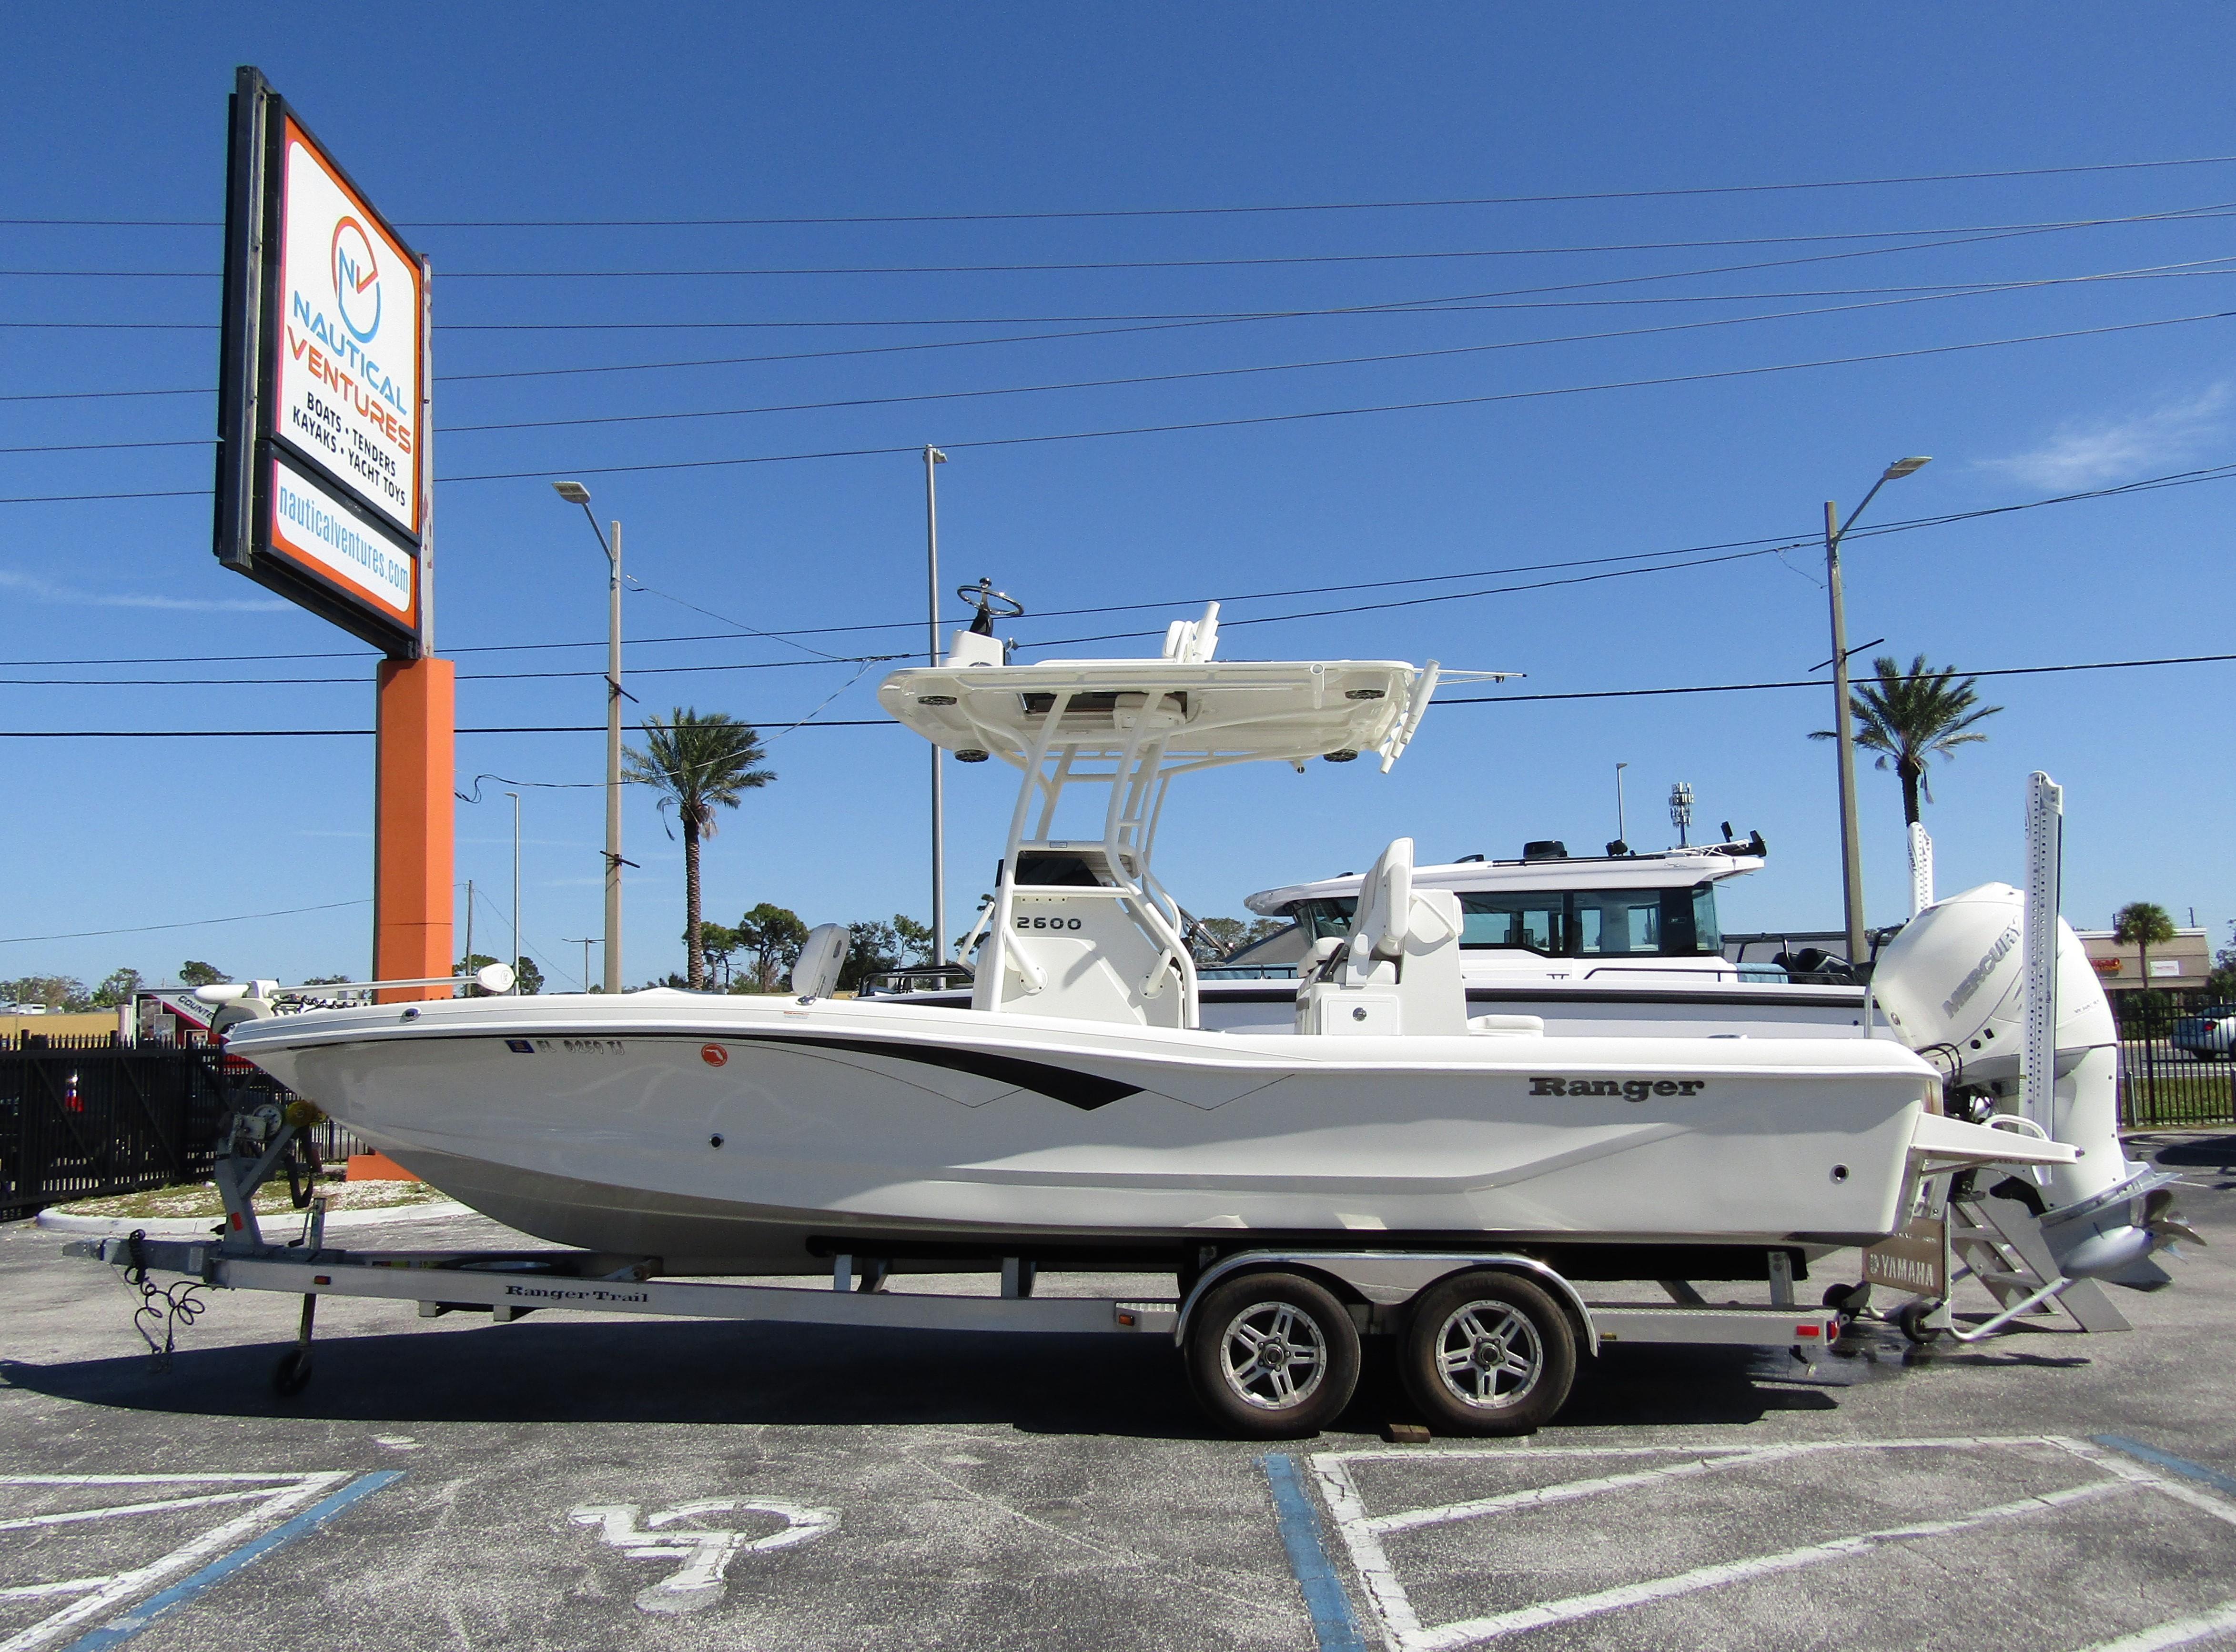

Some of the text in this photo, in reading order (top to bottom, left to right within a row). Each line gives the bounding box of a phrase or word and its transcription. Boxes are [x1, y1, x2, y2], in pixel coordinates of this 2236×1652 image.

[287, 325, 411, 454] VENTURES
[293, 290, 407, 415] NAUTICAL
[293, 405, 405, 506] KAYAKS YACHT TOYS
[307, 391, 395, 477] BOATS TENDERS
[280, 486, 408, 594] nauticalventures.com
[1017, 917, 1082, 929] 2600
[1942, 915, 2021, 1019] MERCURY
[536, 1040, 556, 1052] FL
[1529, 1078, 1704, 1102] Ranger
[506, 1285, 649, 1302] Ranger Trail
[1882, 1254, 1934, 1287] YAMAHA
